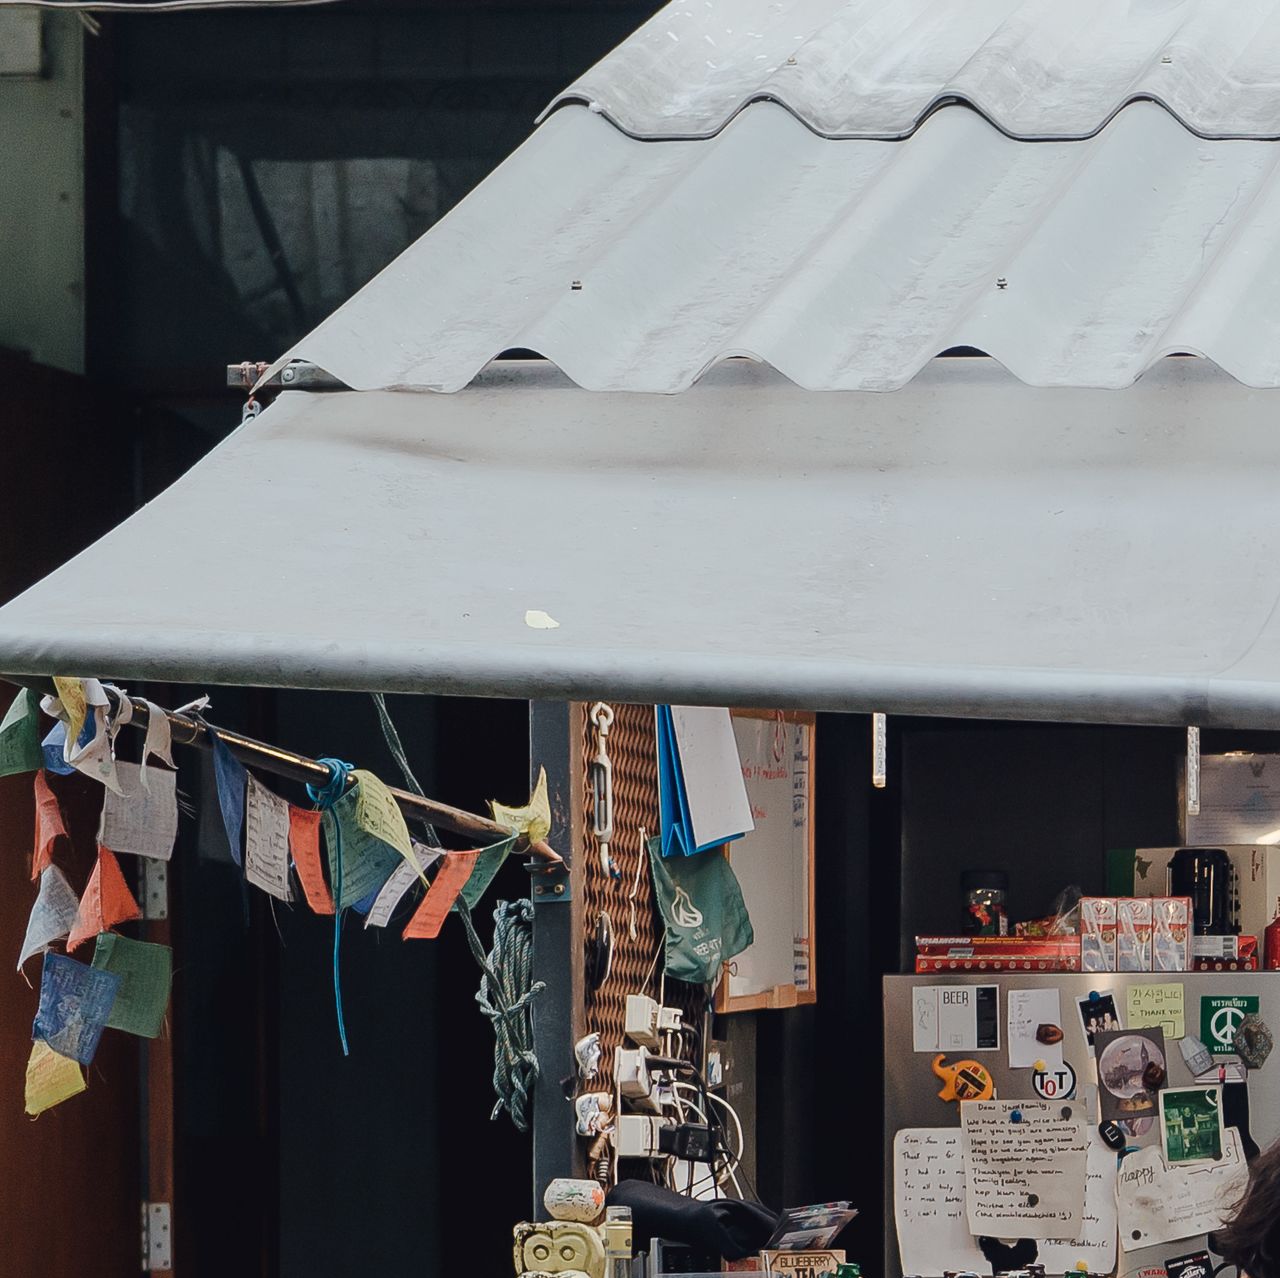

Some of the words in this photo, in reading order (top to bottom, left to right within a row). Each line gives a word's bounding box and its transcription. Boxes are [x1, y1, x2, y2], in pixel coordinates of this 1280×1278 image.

[943, 991, 969, 1005] BEER
[1140, 1009, 1166, 1017] THANK
[1168, 1008, 1182, 1016] YOU
[978, 1103, 995, 1111] Dear
[780, 1256, 832, 1268] BLUEBERRY
